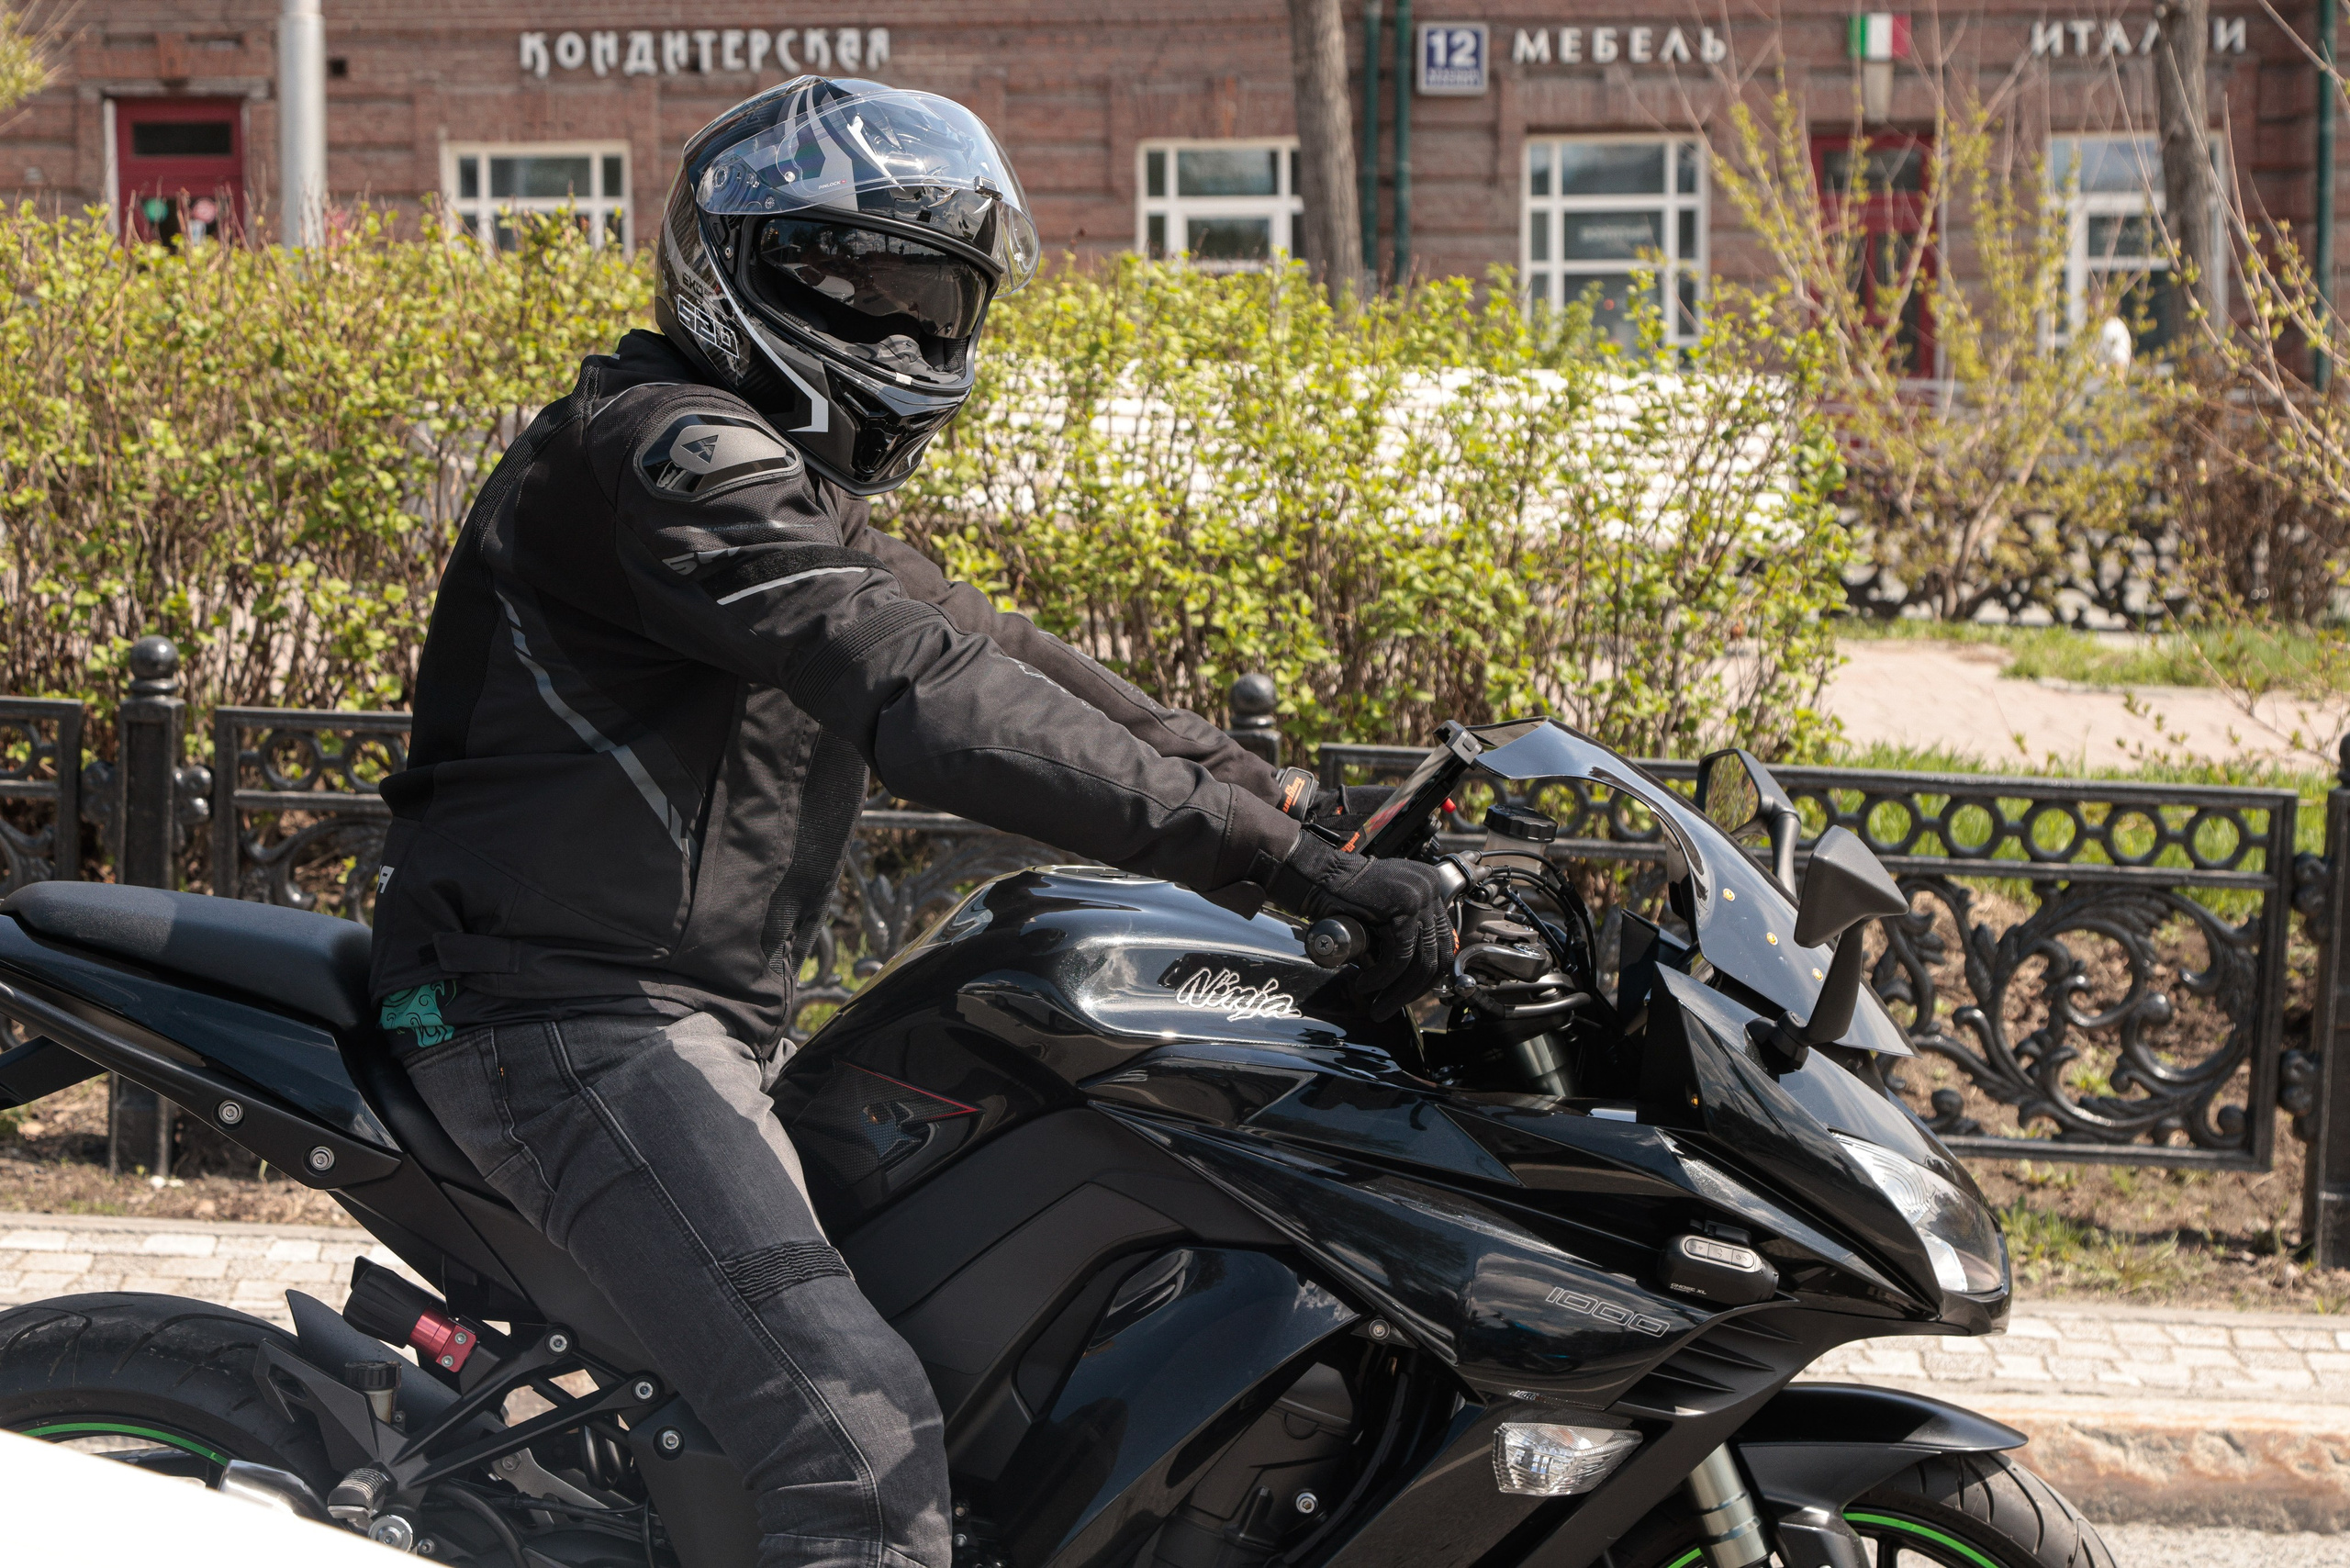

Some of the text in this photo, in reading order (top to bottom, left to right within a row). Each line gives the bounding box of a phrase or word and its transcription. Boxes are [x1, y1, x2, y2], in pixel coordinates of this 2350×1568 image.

[520, 28, 890, 78] КОНДИТЕРСКАЯ
[1428, 28, 1477, 67] 12
[1513, 17, 2246, 63] МЕБЕЛЬ ИТАЛИ
[1177, 967, 1303, 1022] Ninja
[1546, 1287, 1670, 1338] 1000
